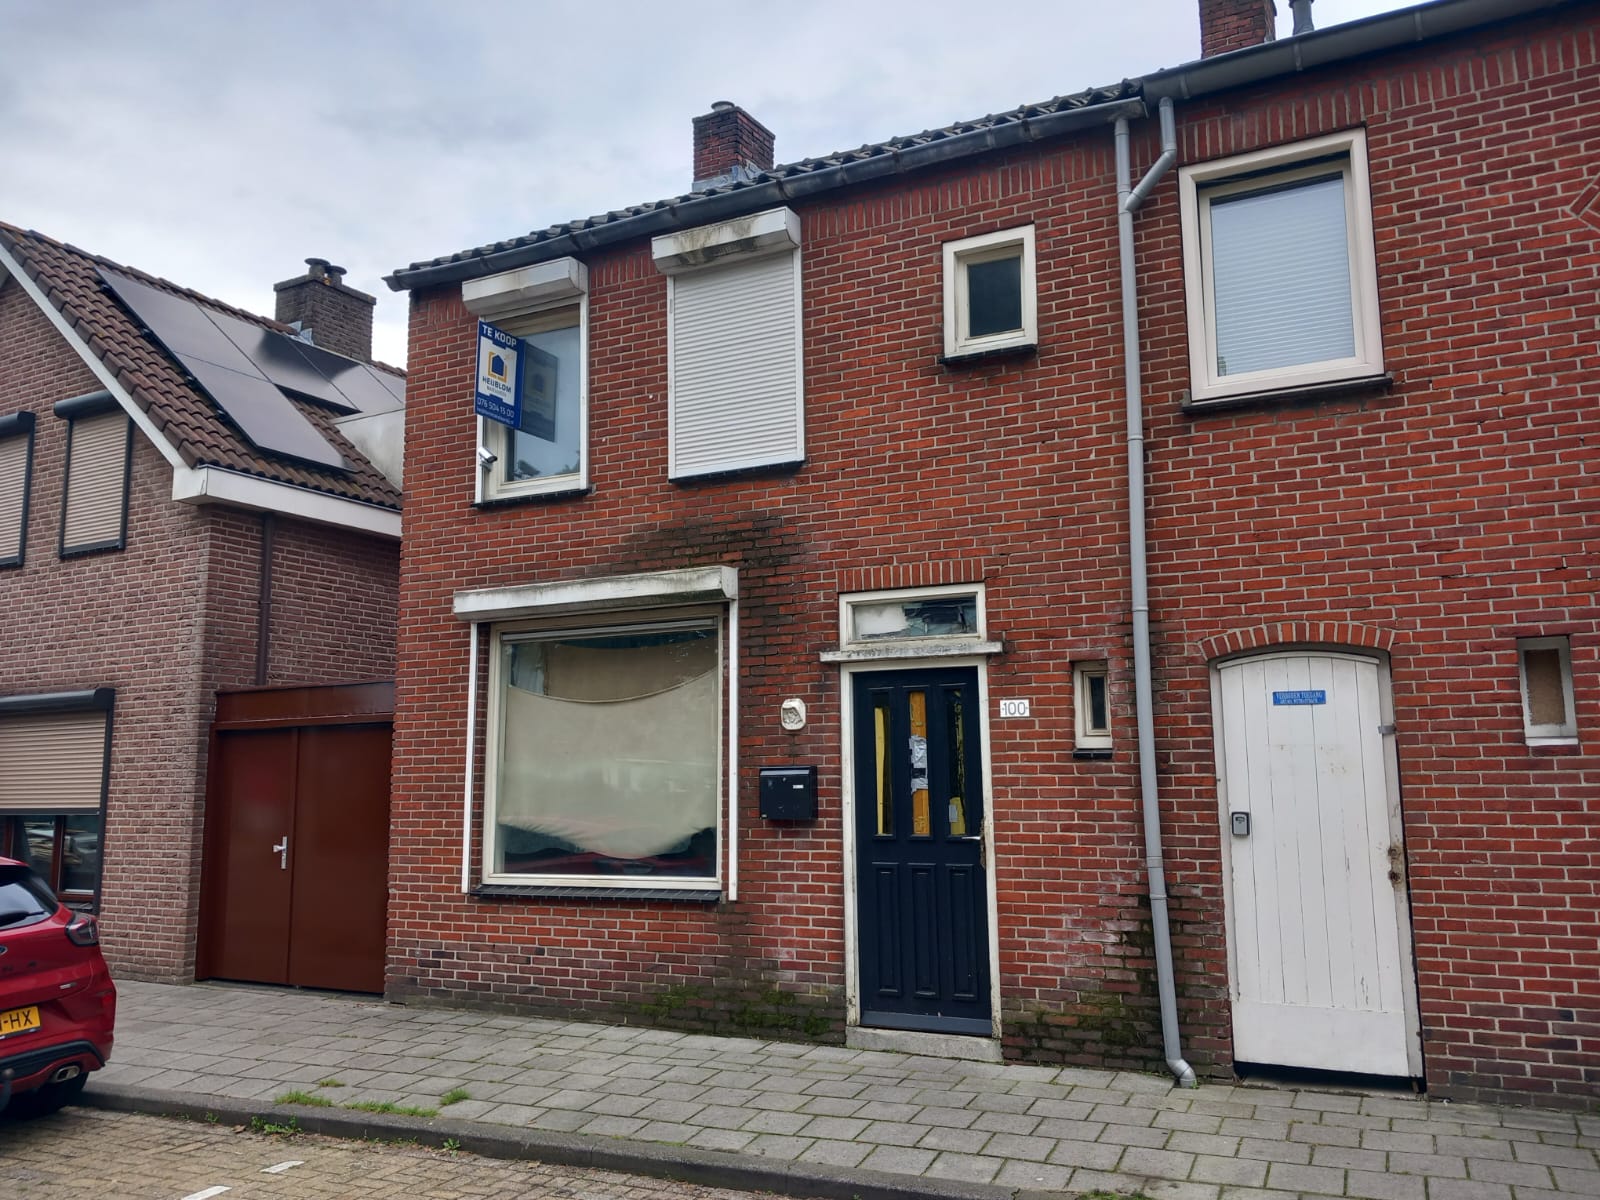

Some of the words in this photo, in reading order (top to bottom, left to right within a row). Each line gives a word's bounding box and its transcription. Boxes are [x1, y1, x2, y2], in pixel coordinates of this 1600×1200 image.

[482, 324, 493, 337] TE
[494, 329, 517, 347] KOOP
[1003, 701, 1026, 716] 100
